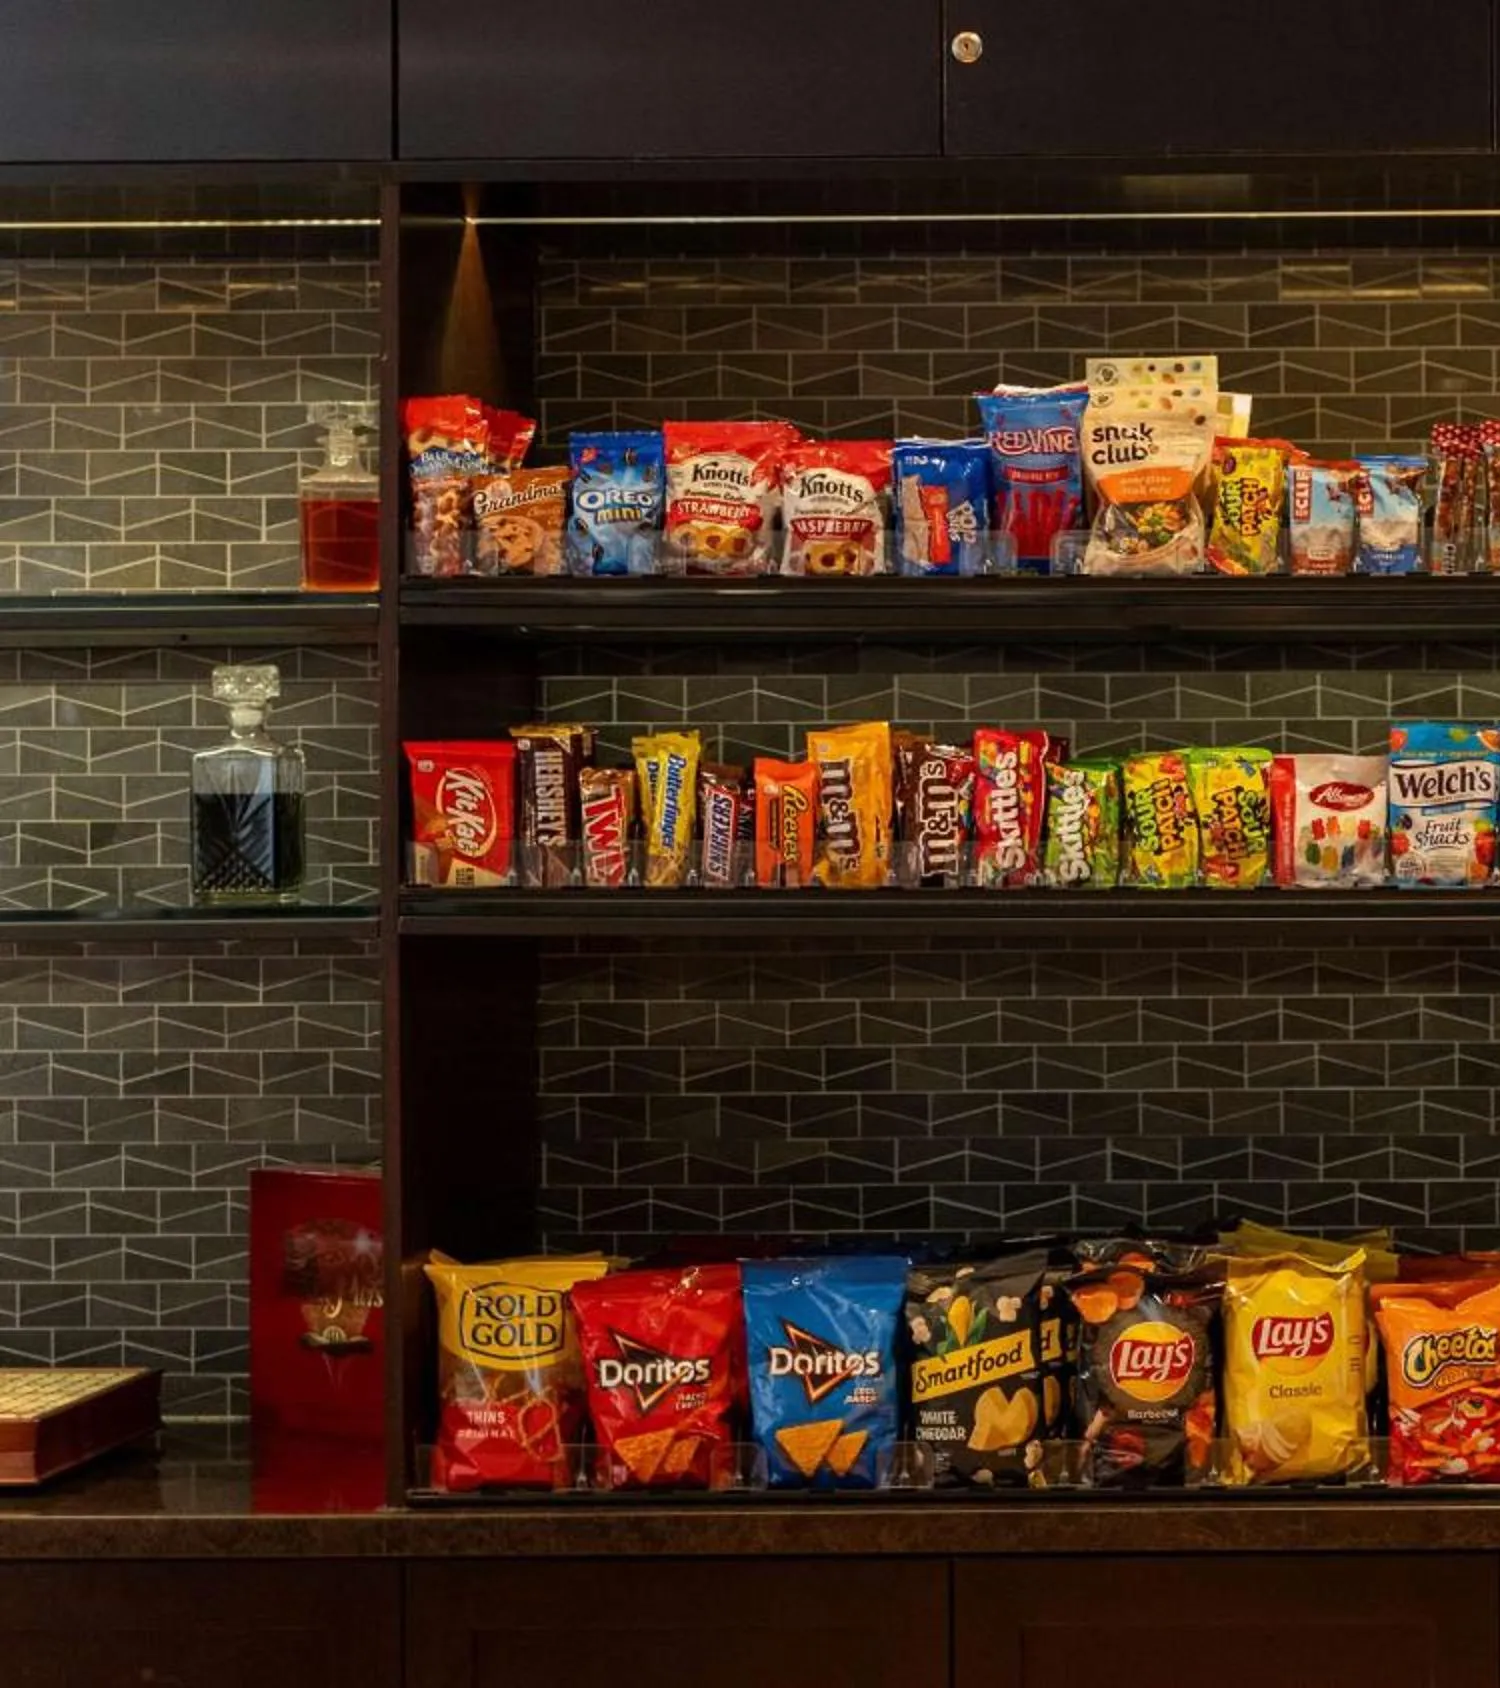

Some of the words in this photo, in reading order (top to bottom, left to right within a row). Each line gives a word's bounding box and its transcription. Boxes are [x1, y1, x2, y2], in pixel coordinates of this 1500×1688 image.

[1029, 428, 1077, 453] VINE
[1091, 423, 1154, 443] snak
[1091, 443, 1149, 465] club
[577, 487, 653, 511] OREO
[595, 507, 642, 525] mini
[1394, 766, 1491, 799] Welch's
[661, 753, 687, 848] Butterfinger
[1136, 788, 1159, 851] SOUR
[1151, 778, 1182, 851] PATCH
[1425, 817, 1462, 835] Fruit
[1415, 830, 1471, 849] Snacks
[474, 1295, 557, 1319] ROLD
[472, 1322, 557, 1347] GOLD
[1257, 1312, 1332, 1358] Lay's
[769, 1347, 881, 1376] Doritos
[915, 1343, 1024, 1394] Smartfood
[1118, 1334, 1191, 1383] Lay's
[600, 1358, 710, 1388] Doritos
[1269, 1382, 1323, 1400] Classic
[467, 1411, 506, 1424] THINS
[919, 1410, 957, 1426] WHITE
[1127, 1408, 1179, 1420] Barbecue
[916, 1426, 967, 1441] CHEDDAR
